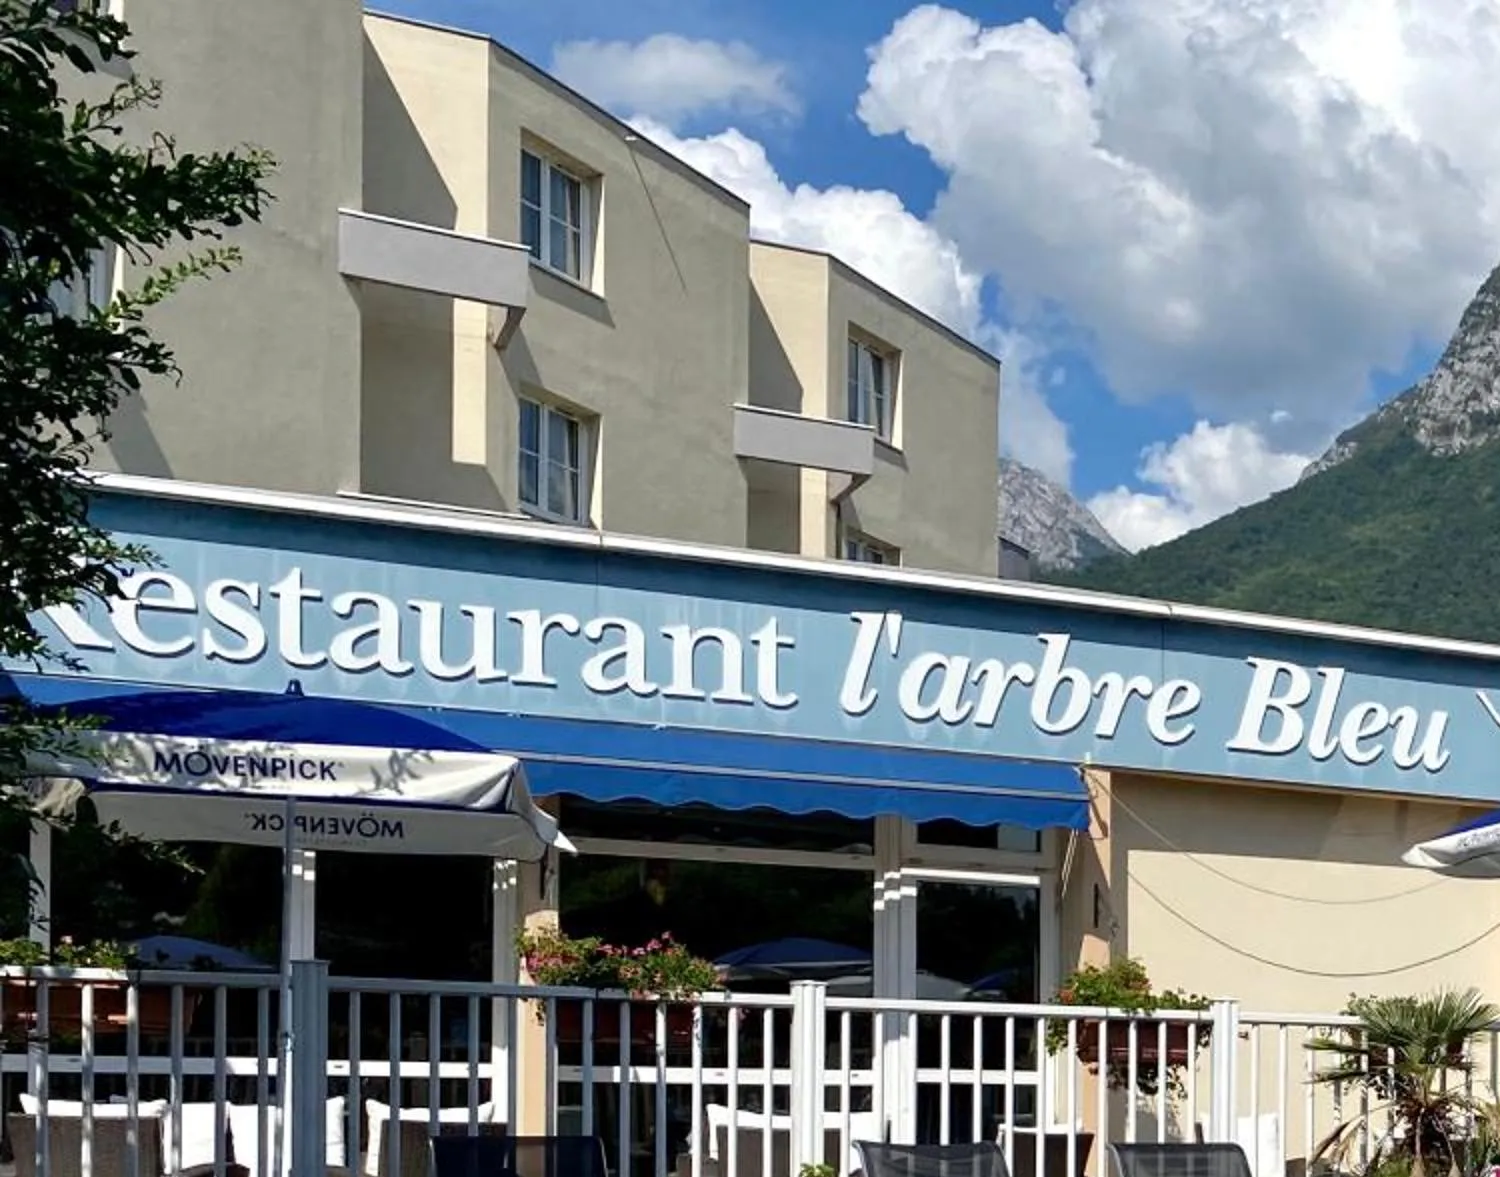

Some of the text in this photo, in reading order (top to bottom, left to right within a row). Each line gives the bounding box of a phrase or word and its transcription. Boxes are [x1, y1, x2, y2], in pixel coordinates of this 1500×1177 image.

[840, 609, 1202, 745] l'arbre
[1225, 655, 1451, 774] Bleu
[153, 745, 338, 782] MÖVENPICK
